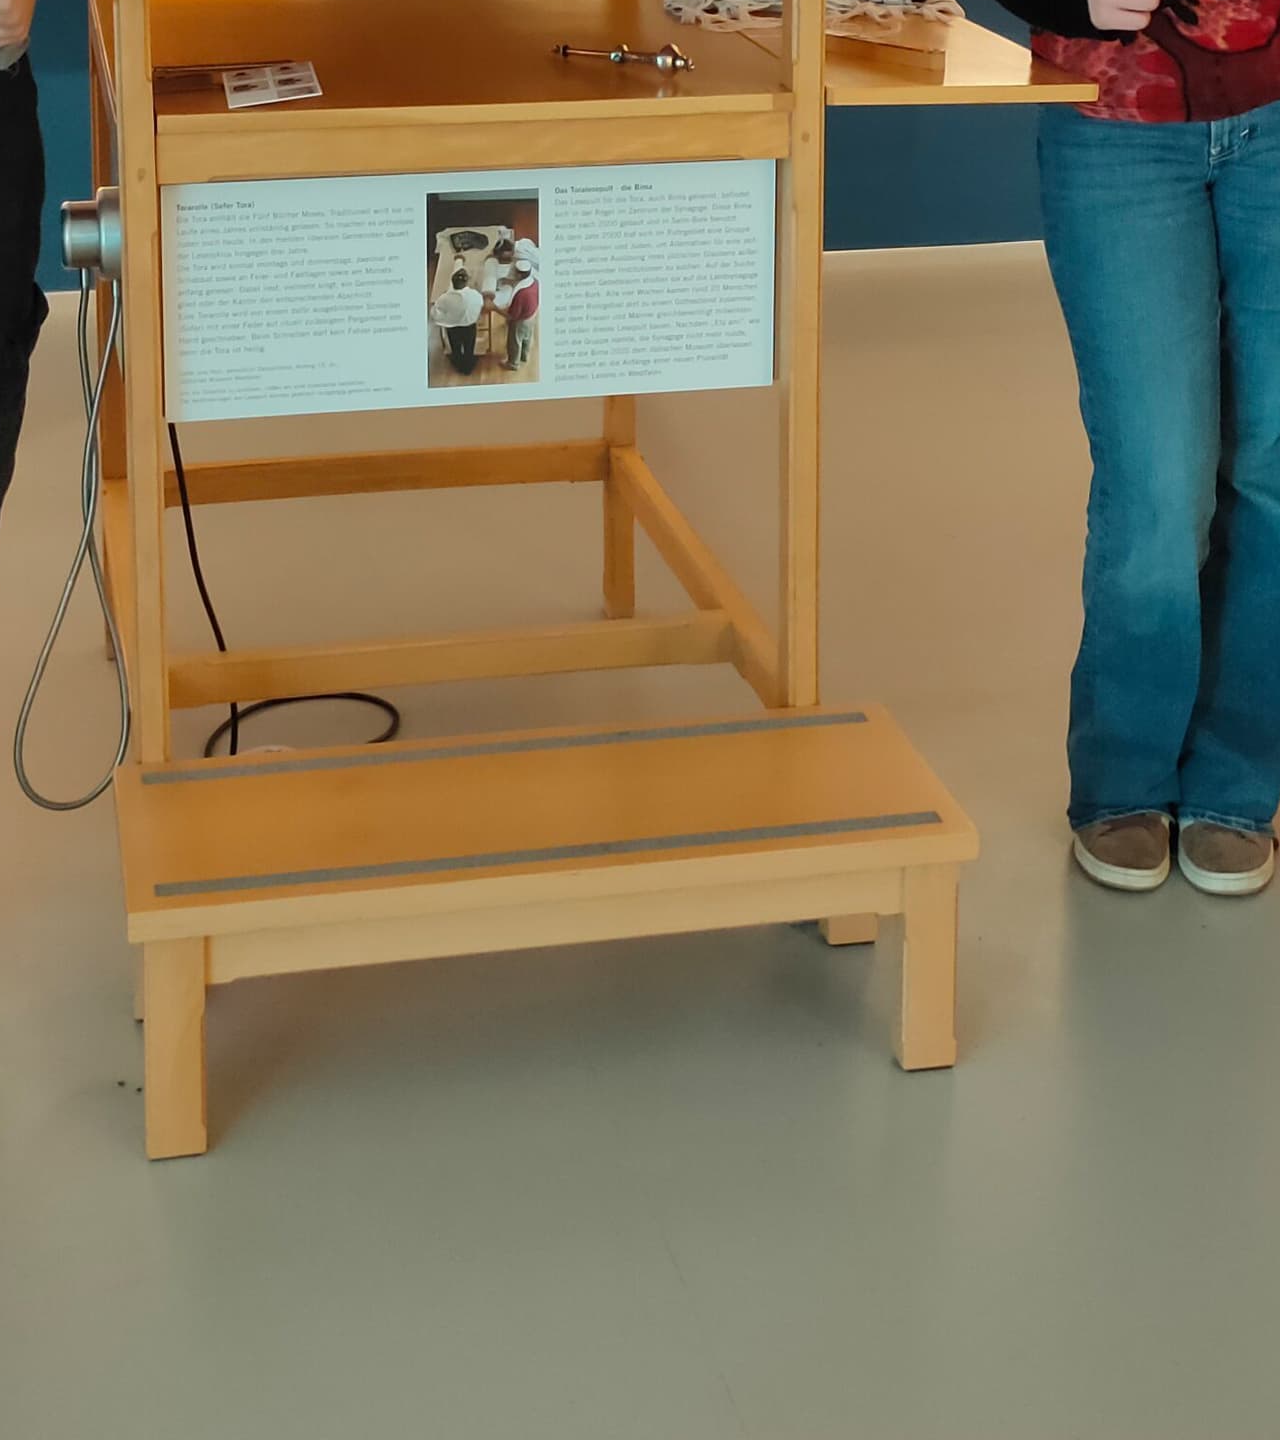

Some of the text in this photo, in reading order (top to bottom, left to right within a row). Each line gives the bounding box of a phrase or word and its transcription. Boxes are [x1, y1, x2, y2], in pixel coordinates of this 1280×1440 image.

[620, 184, 632, 192] die
[633, 183, 653, 191] Bima
[236, 201, 255, 210] Tora)
